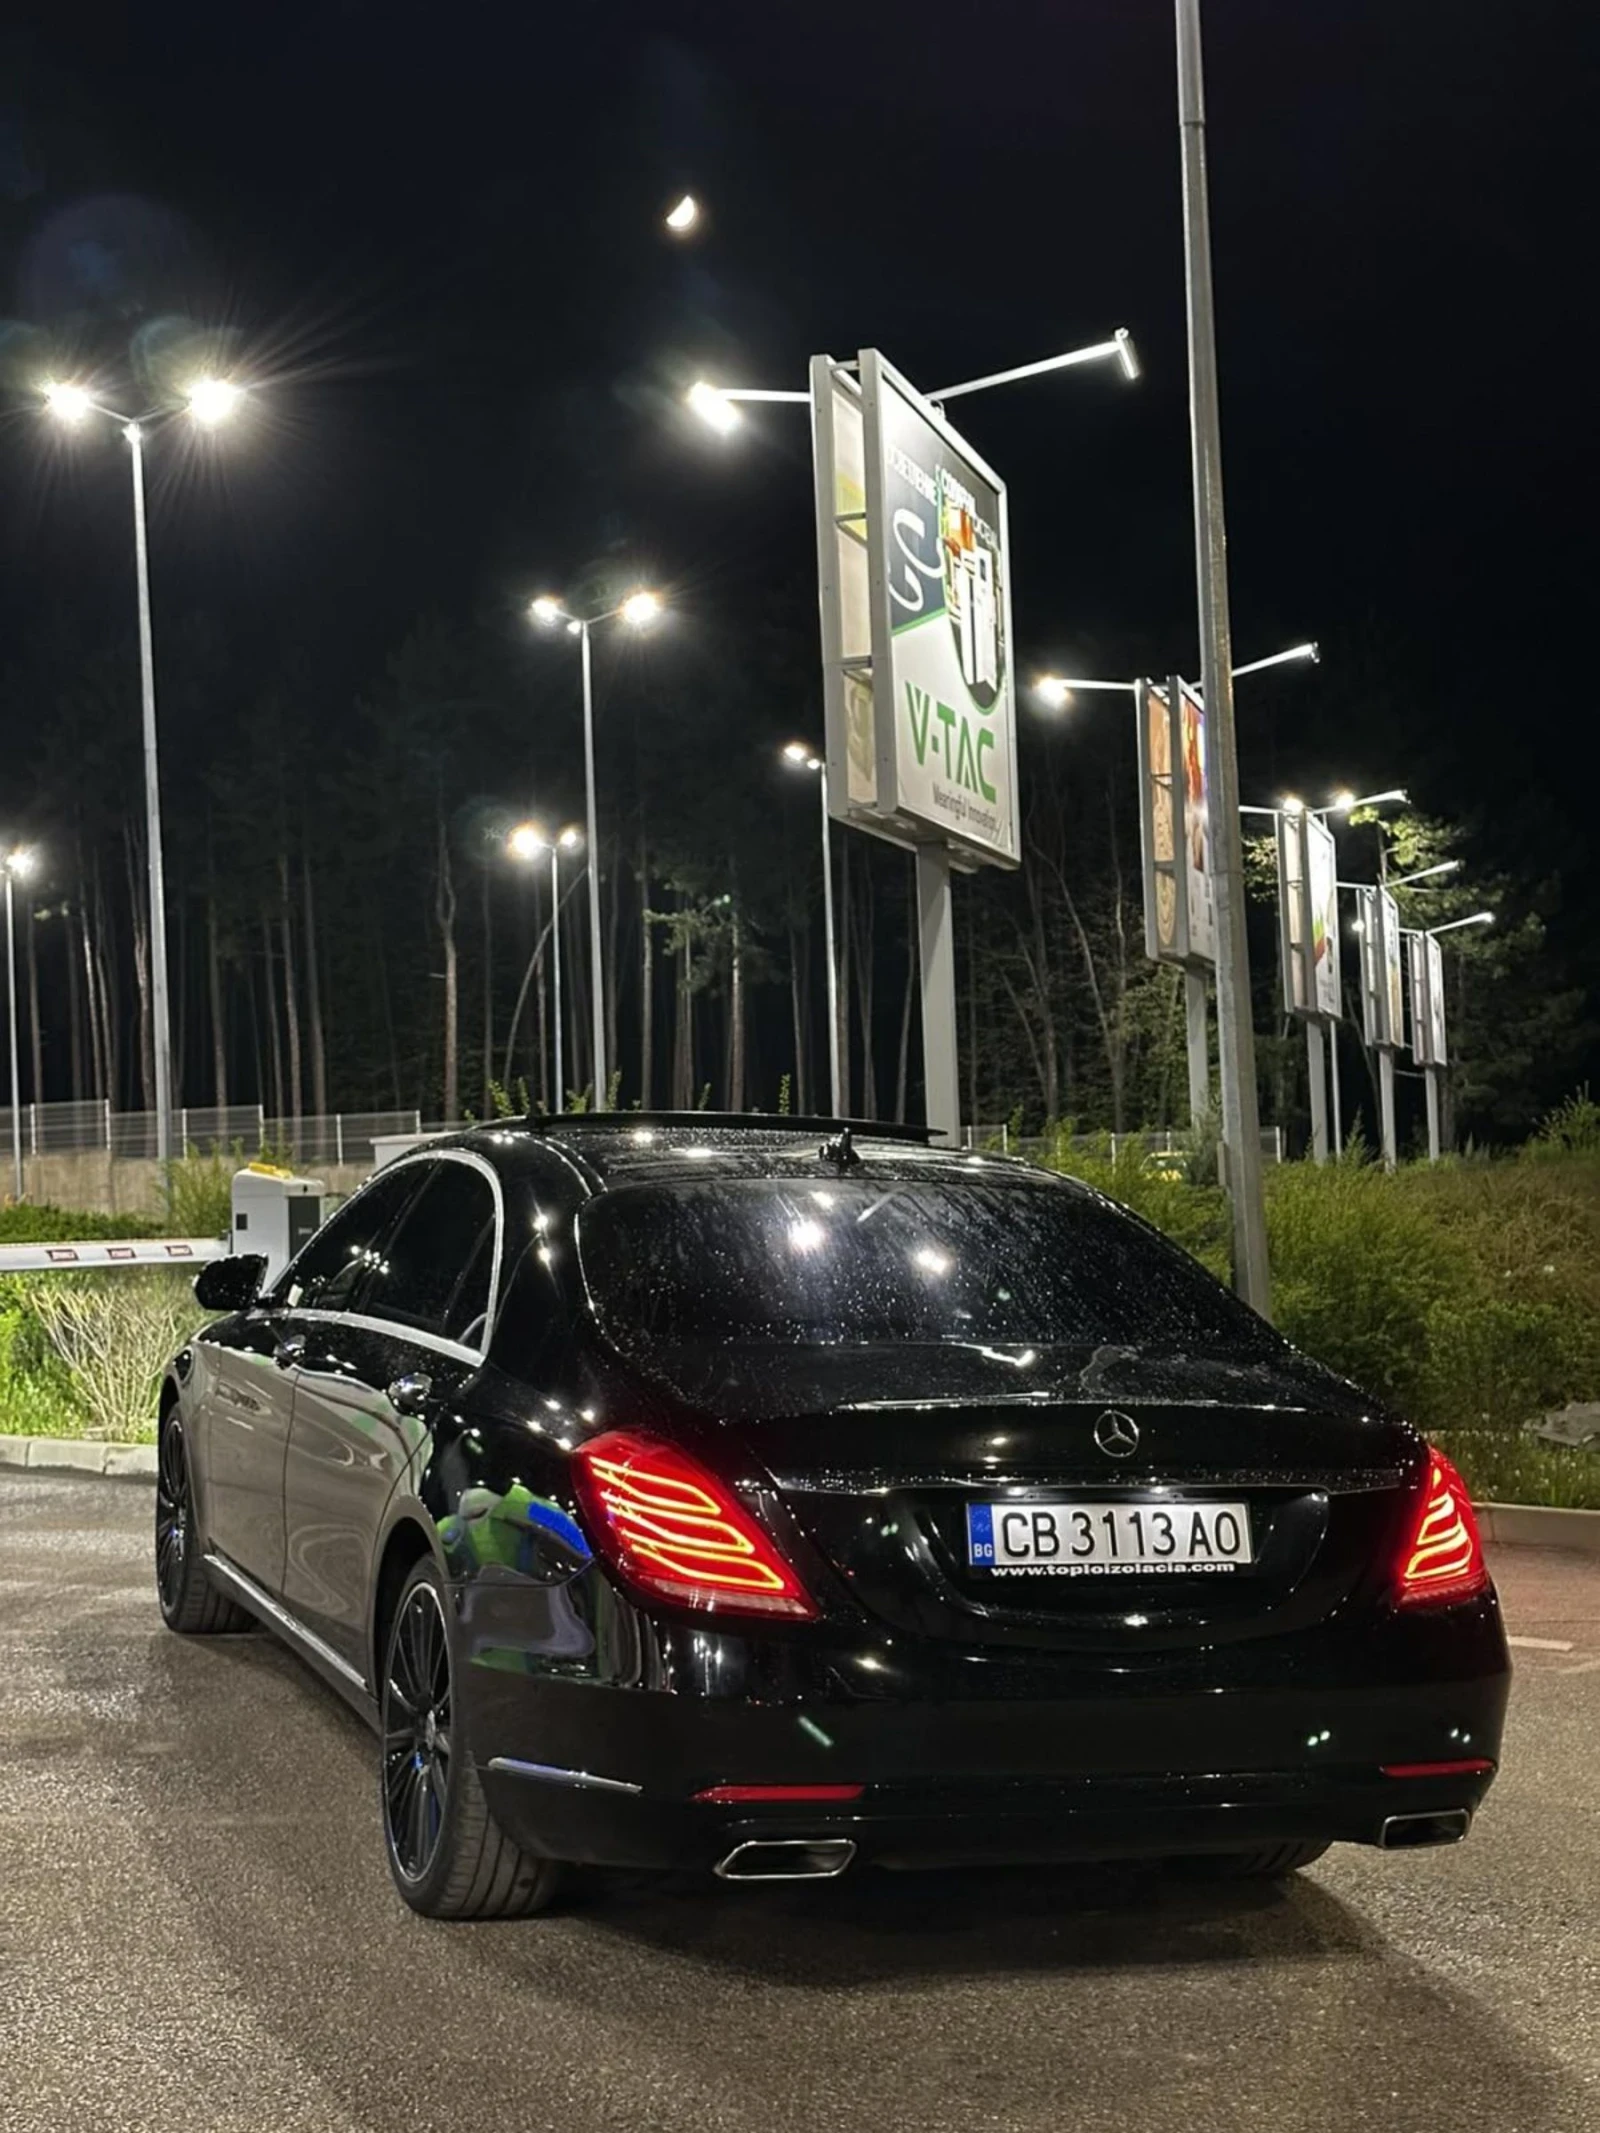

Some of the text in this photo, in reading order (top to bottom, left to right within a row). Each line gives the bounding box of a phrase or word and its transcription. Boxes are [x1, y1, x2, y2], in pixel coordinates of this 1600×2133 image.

[905, 680, 996, 804] V-TAC
[1002, 1511, 1060, 1557] CB
[1071, 1510, 1176, 1557] 3113
[973, 1543, 993, 1558] BG
[991, 1562, 1235, 1577] www.toploizolacia.com
